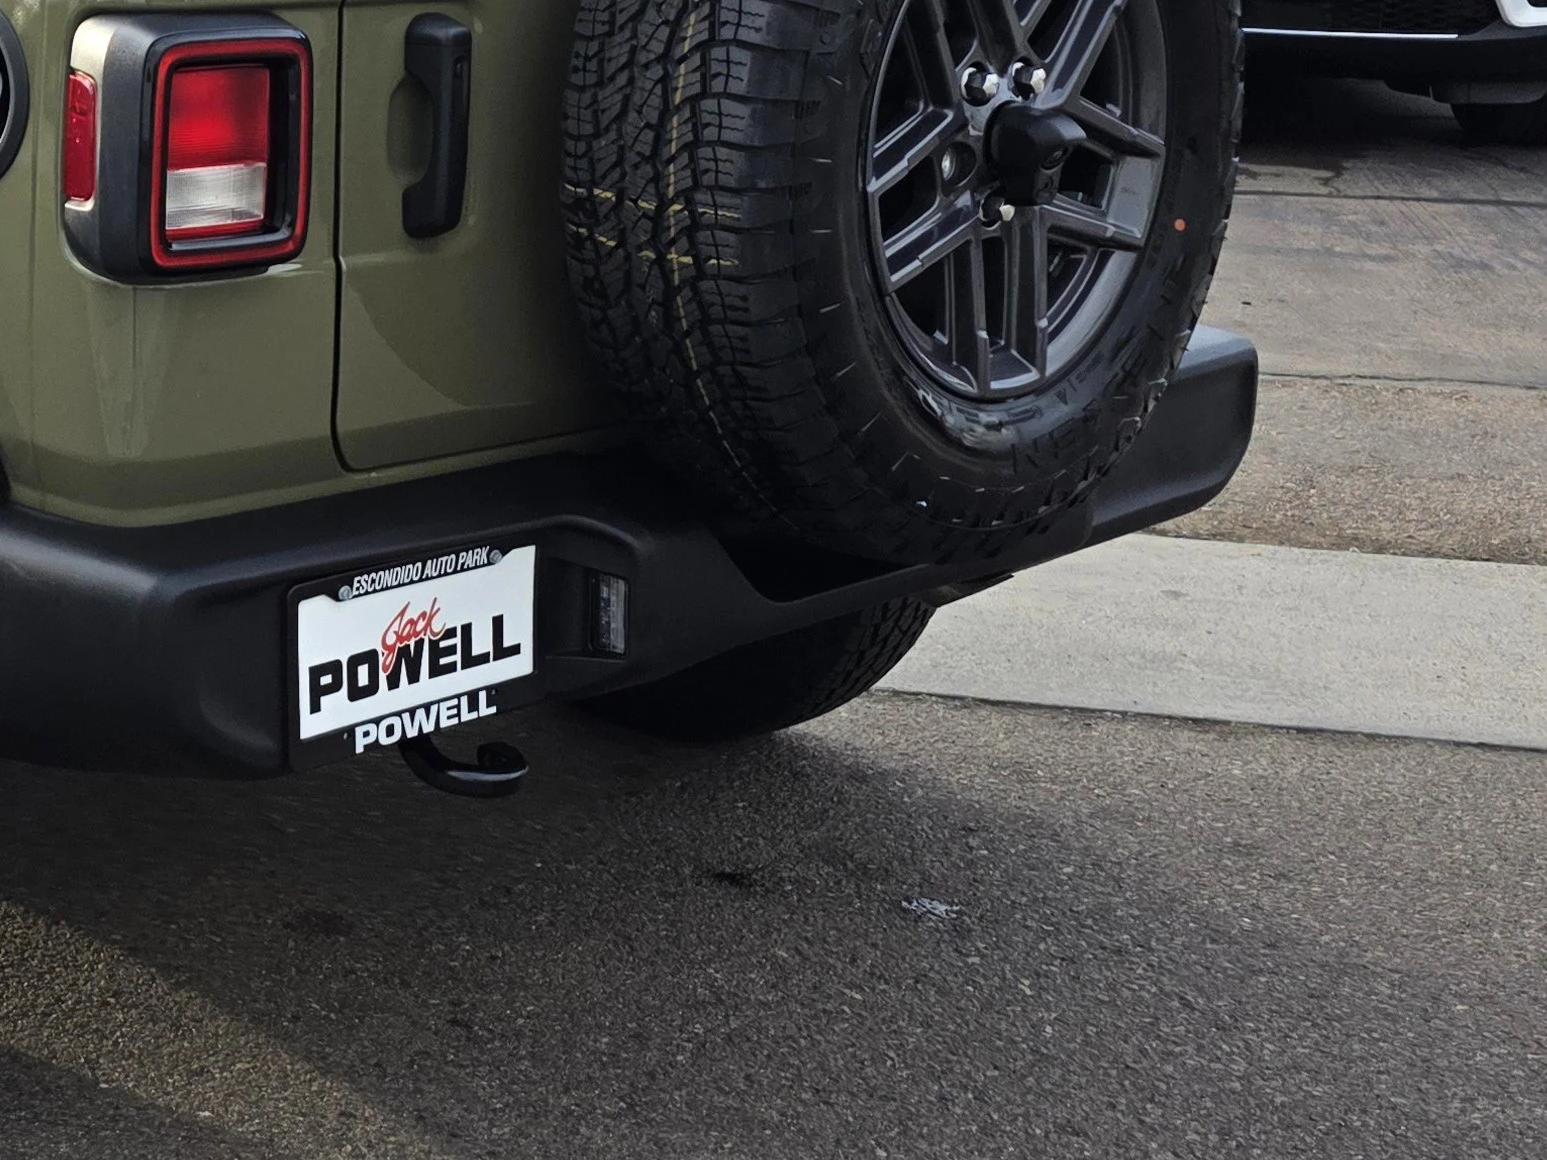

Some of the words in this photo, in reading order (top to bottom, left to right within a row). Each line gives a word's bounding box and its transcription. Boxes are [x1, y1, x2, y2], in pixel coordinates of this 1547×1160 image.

[352, 561, 422, 597] ESCONDIDO
[422, 553, 456, 579] AUTO
[457, 545, 490, 571] PARK
[308, 613, 522, 715] POWELL
[380, 596, 447, 676] Jack
[355, 689, 498, 755] POWELL
